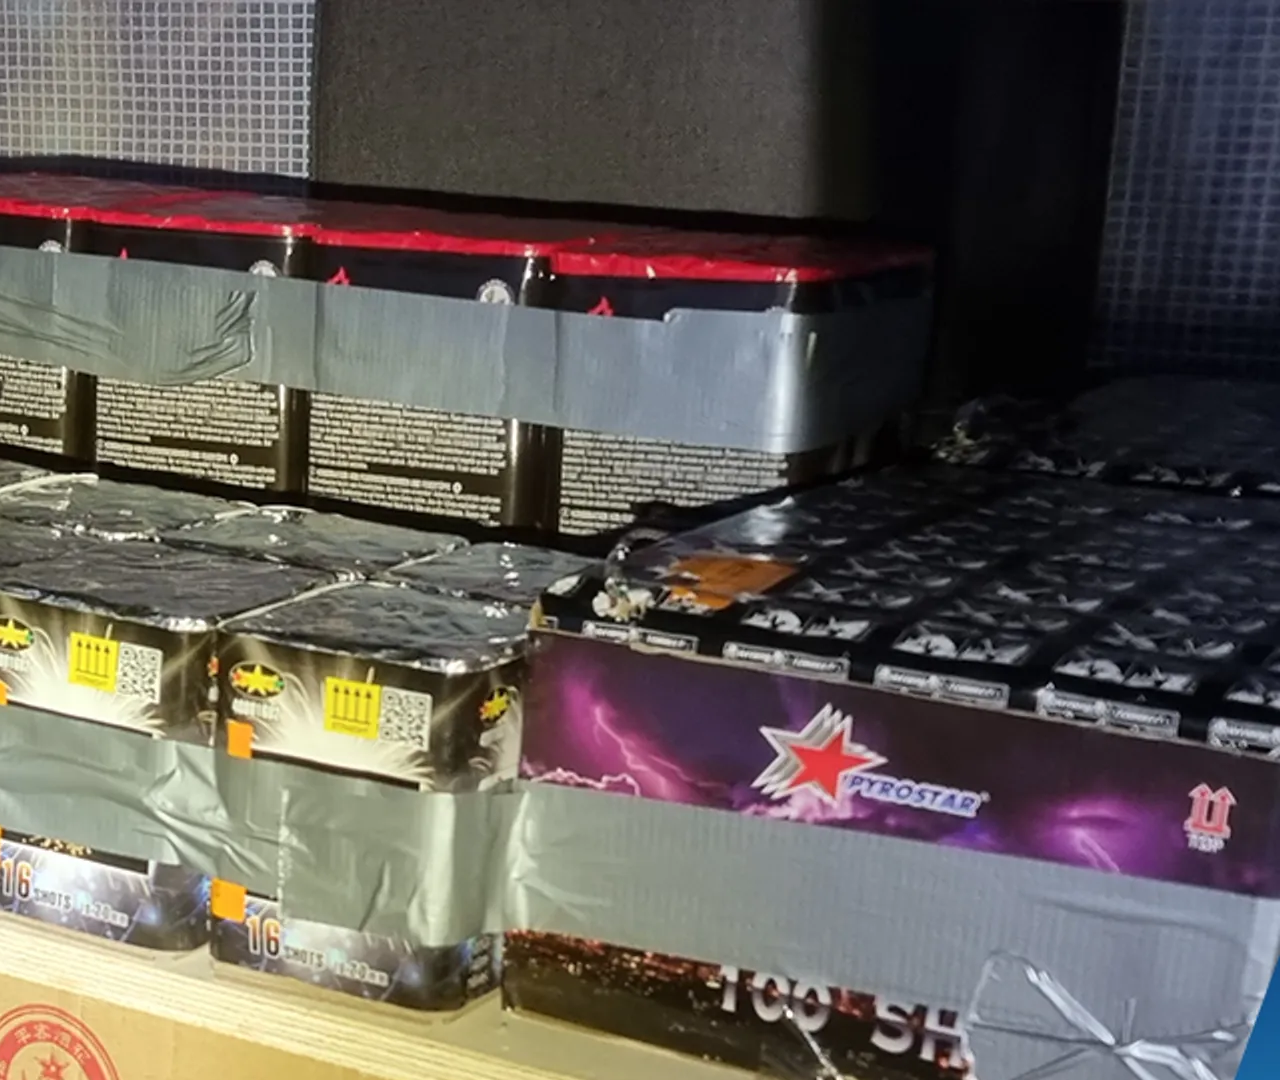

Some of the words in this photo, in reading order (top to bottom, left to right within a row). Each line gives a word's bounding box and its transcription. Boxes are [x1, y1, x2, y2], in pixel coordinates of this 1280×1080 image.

[847, 774, 980, 818] PYROSTAR
[1, 858, 33, 901] 16
[246, 915, 282, 960] 16
